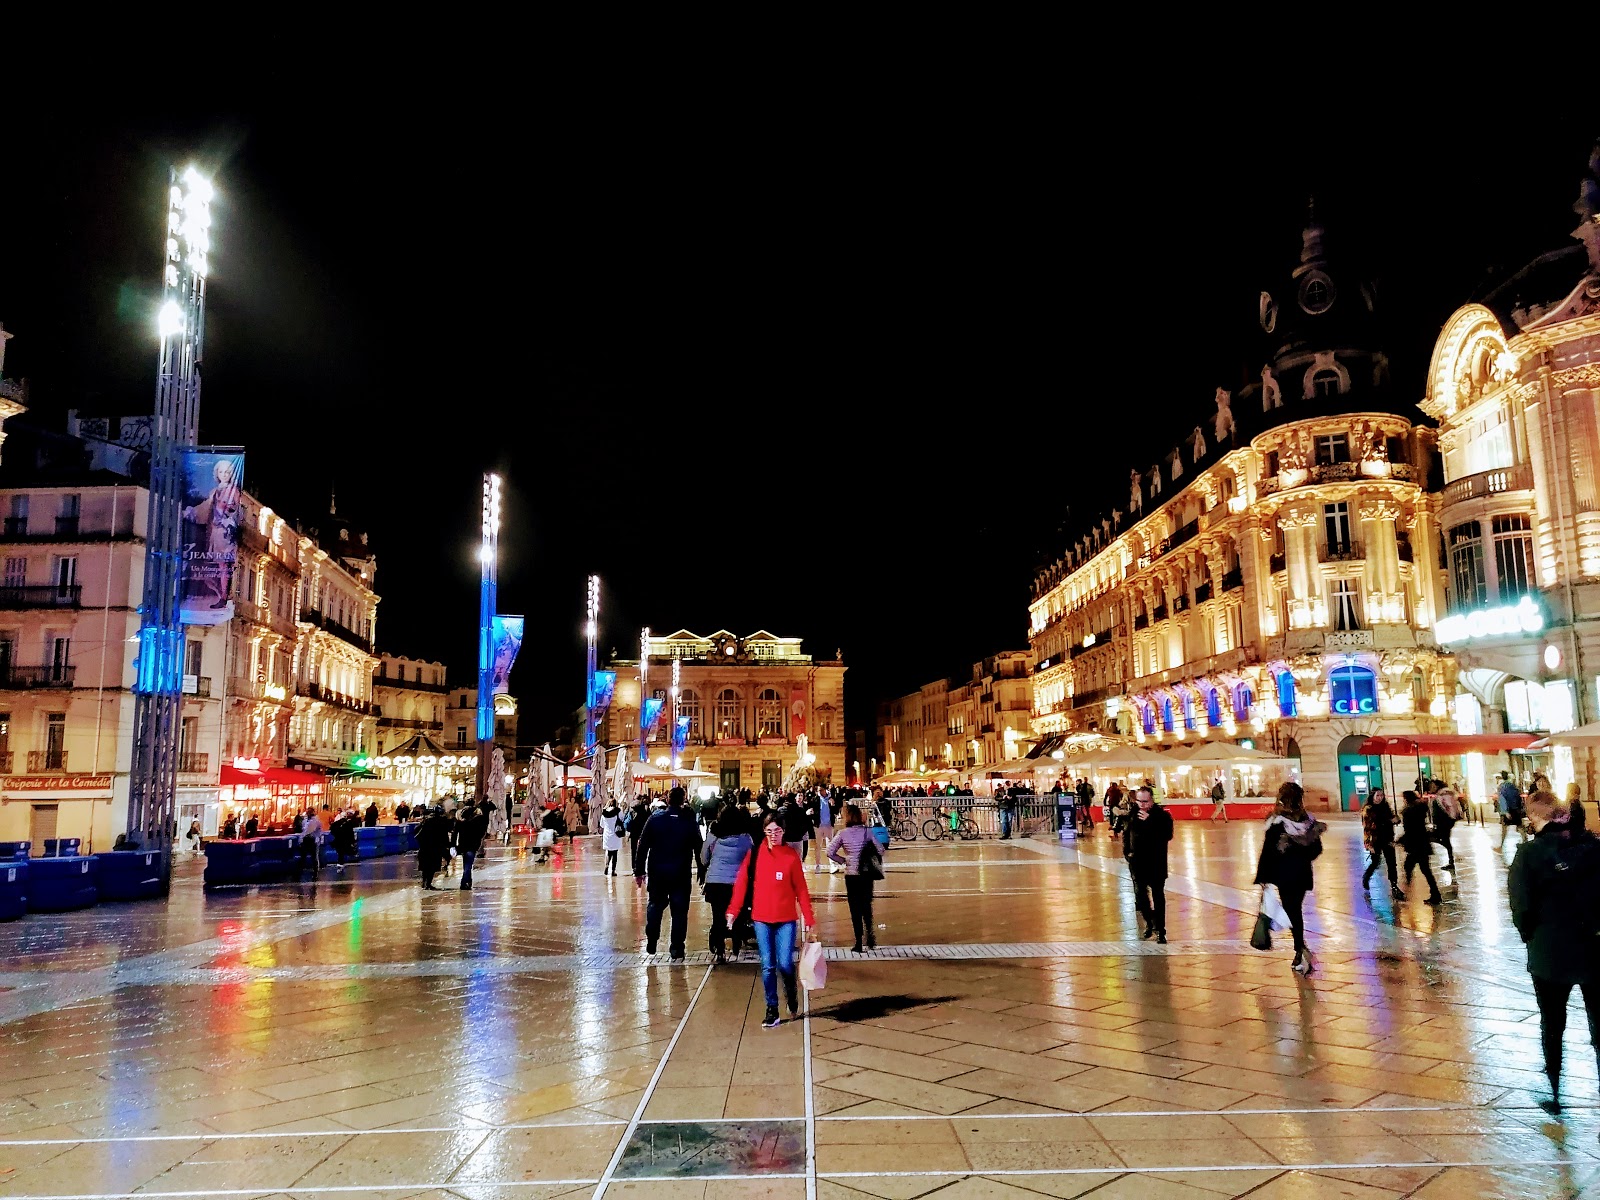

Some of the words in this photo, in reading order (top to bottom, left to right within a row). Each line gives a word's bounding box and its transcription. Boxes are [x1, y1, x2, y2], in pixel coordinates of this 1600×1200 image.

[188, 551, 214, 561] JEAN
[1335, 698, 1374, 714] CIC
[3, 778, 43, 790] Crêperie
[44, 777, 55, 788] de
[58, 777, 69, 788] la
[71, 776, 111, 788] Comédie
